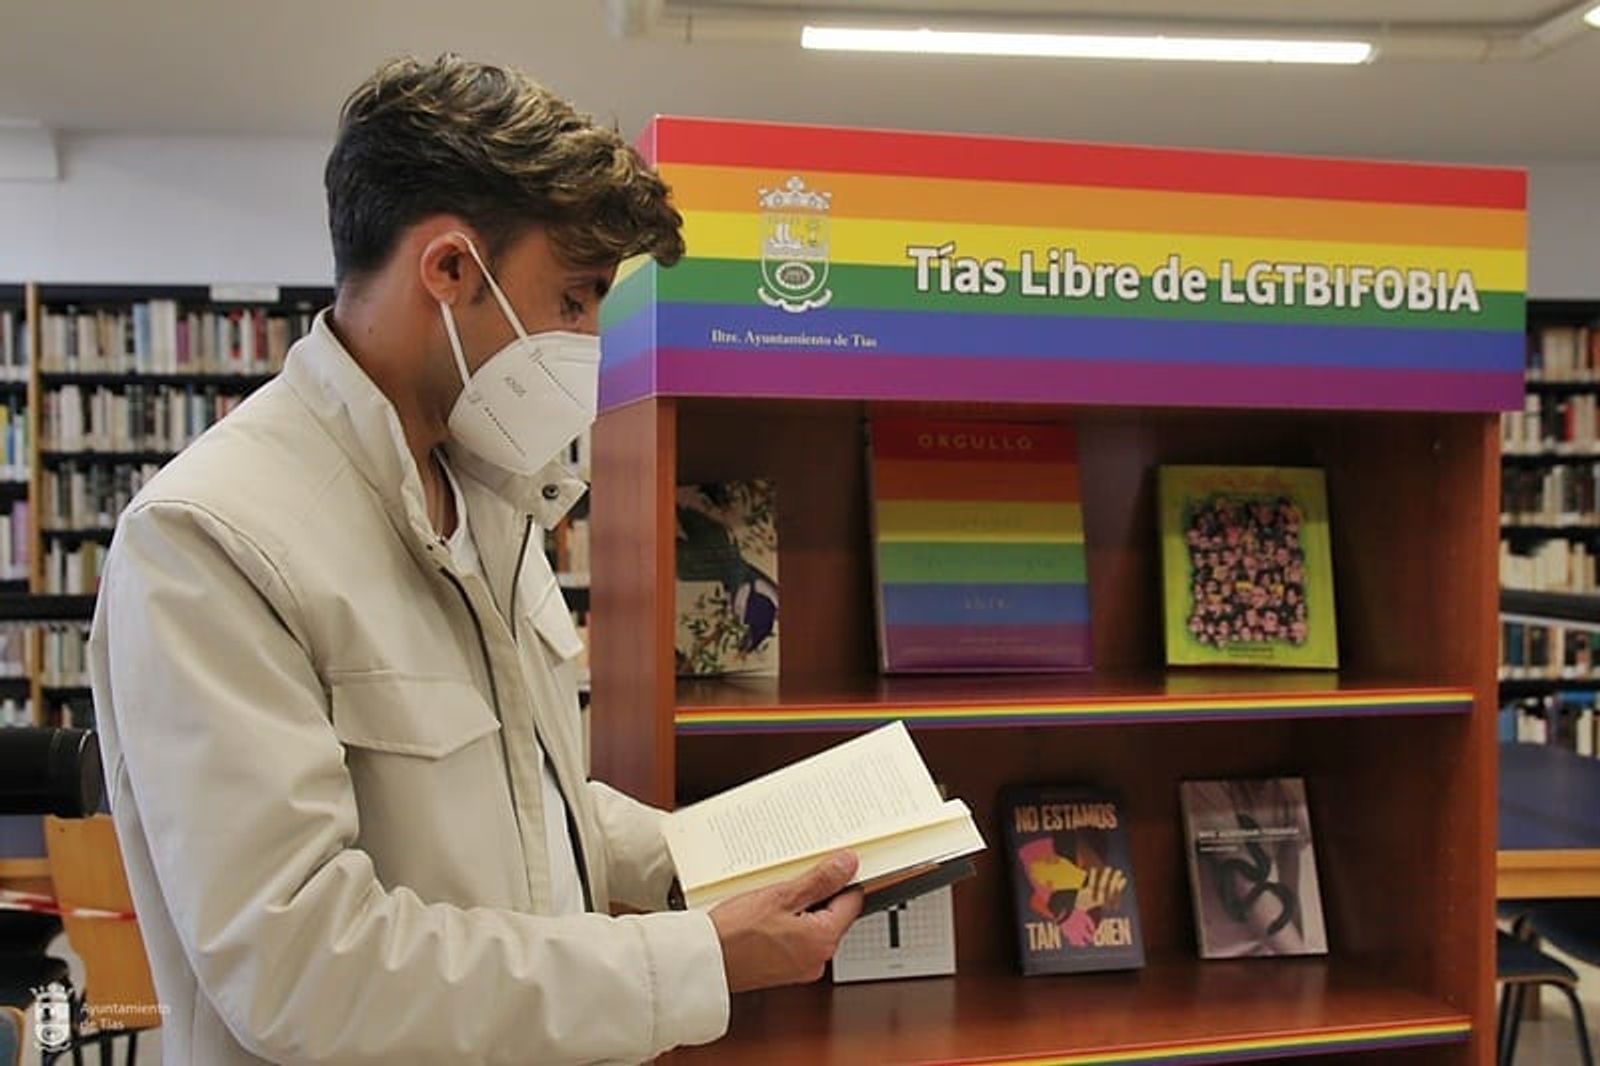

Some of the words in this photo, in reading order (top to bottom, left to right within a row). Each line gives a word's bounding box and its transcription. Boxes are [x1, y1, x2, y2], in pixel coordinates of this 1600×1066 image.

[907, 242, 1007, 295] Tías
[1020, 249, 1141, 300] Libre
[1151, 254, 1208, 302] de
[1219, 259, 1482, 313] LGTBIFOBIA
[744, 329, 832, 347] Ayuntamiento
[834, 333, 849, 347] de
[917, 433, 1034, 450] ORGULLO
[1015, 805, 1039, 833] NO
[1042, 803, 1119, 831] ESTAMOS
[1024, 921, 1062, 951] TAN
